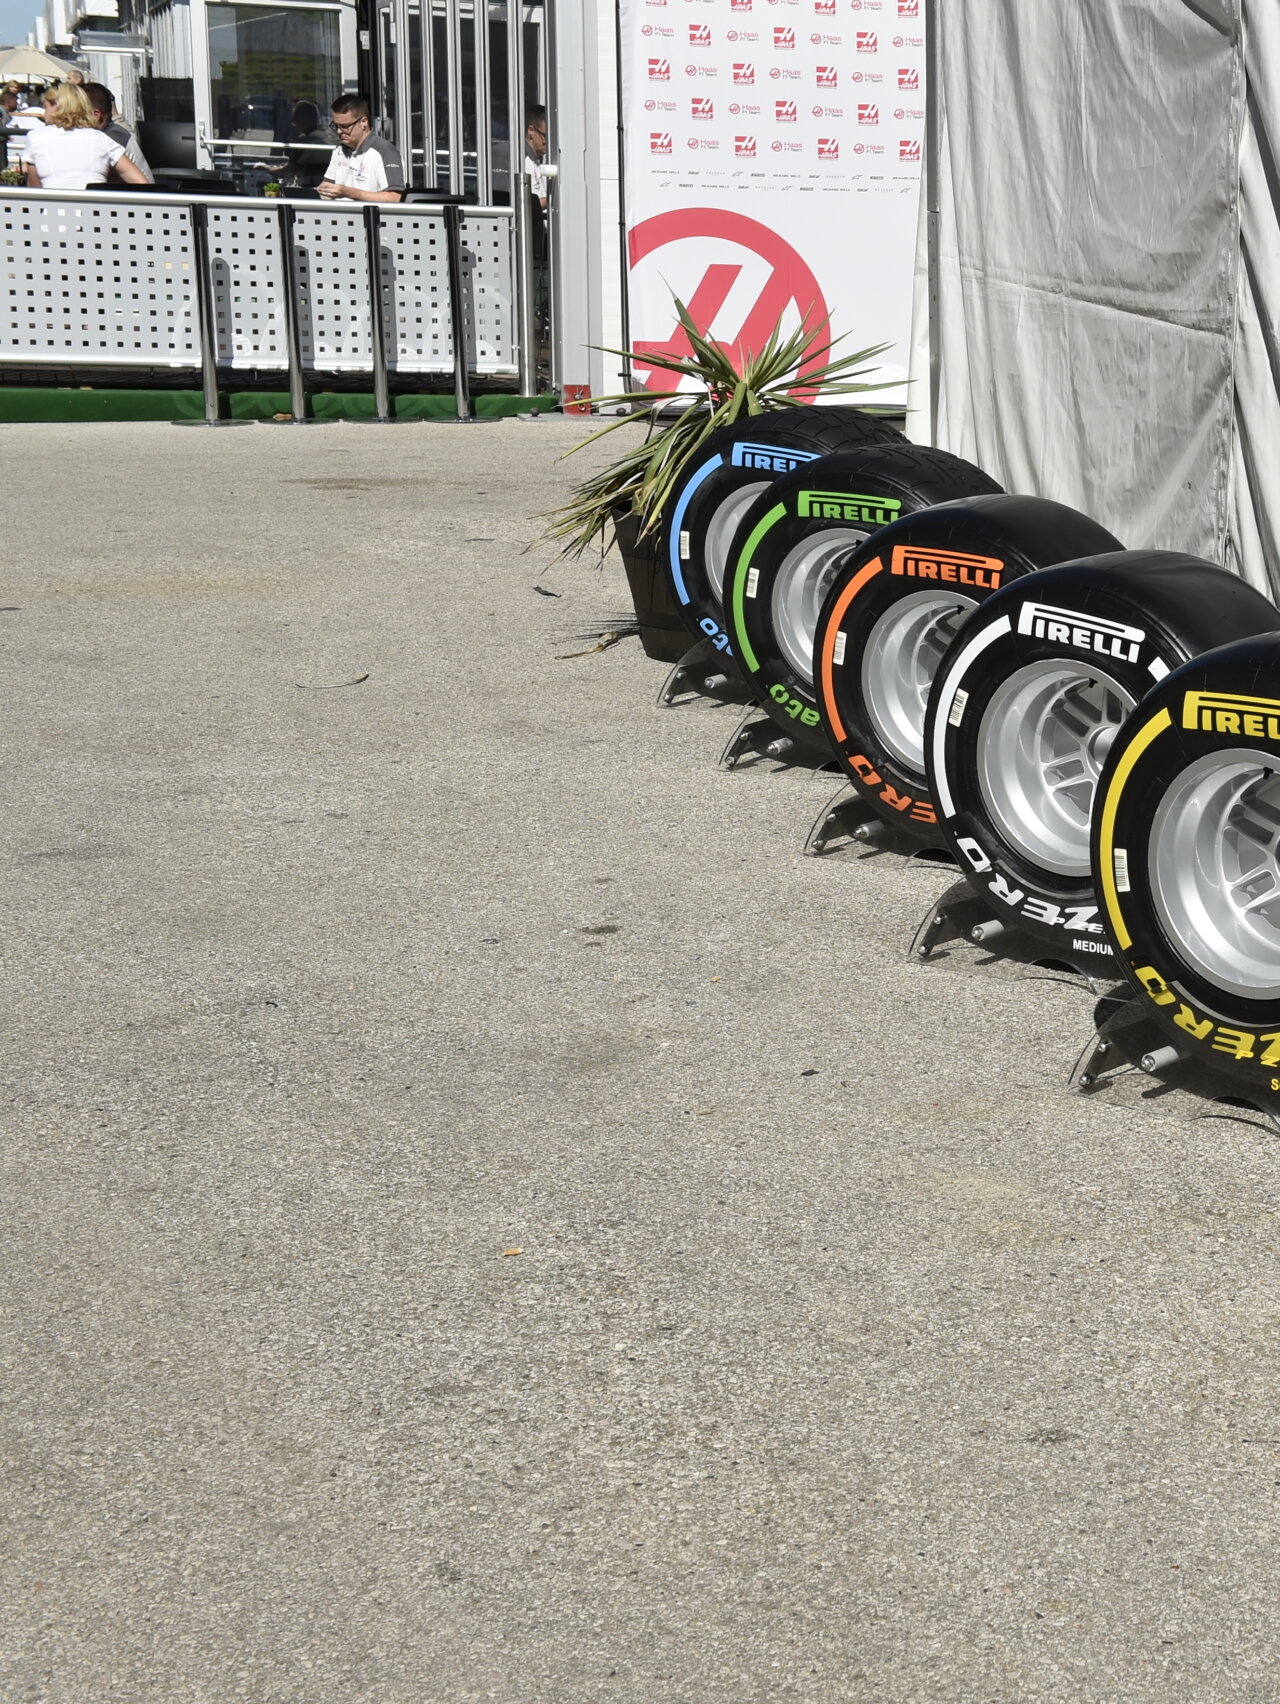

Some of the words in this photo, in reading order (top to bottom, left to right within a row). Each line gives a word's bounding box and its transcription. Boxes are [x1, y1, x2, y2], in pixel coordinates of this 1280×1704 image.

[798, 490, 902, 525] PIRELLI
[891, 545, 1005, 589] PIRELLI
[1018, 602, 1146, 663] PIRELLI
[848, 754, 938, 824] ERO
[956, 837, 1099, 930] ZERO
[1071, 921, 1106, 934] ZE
[1235, 1051, 1255, 1060] P
